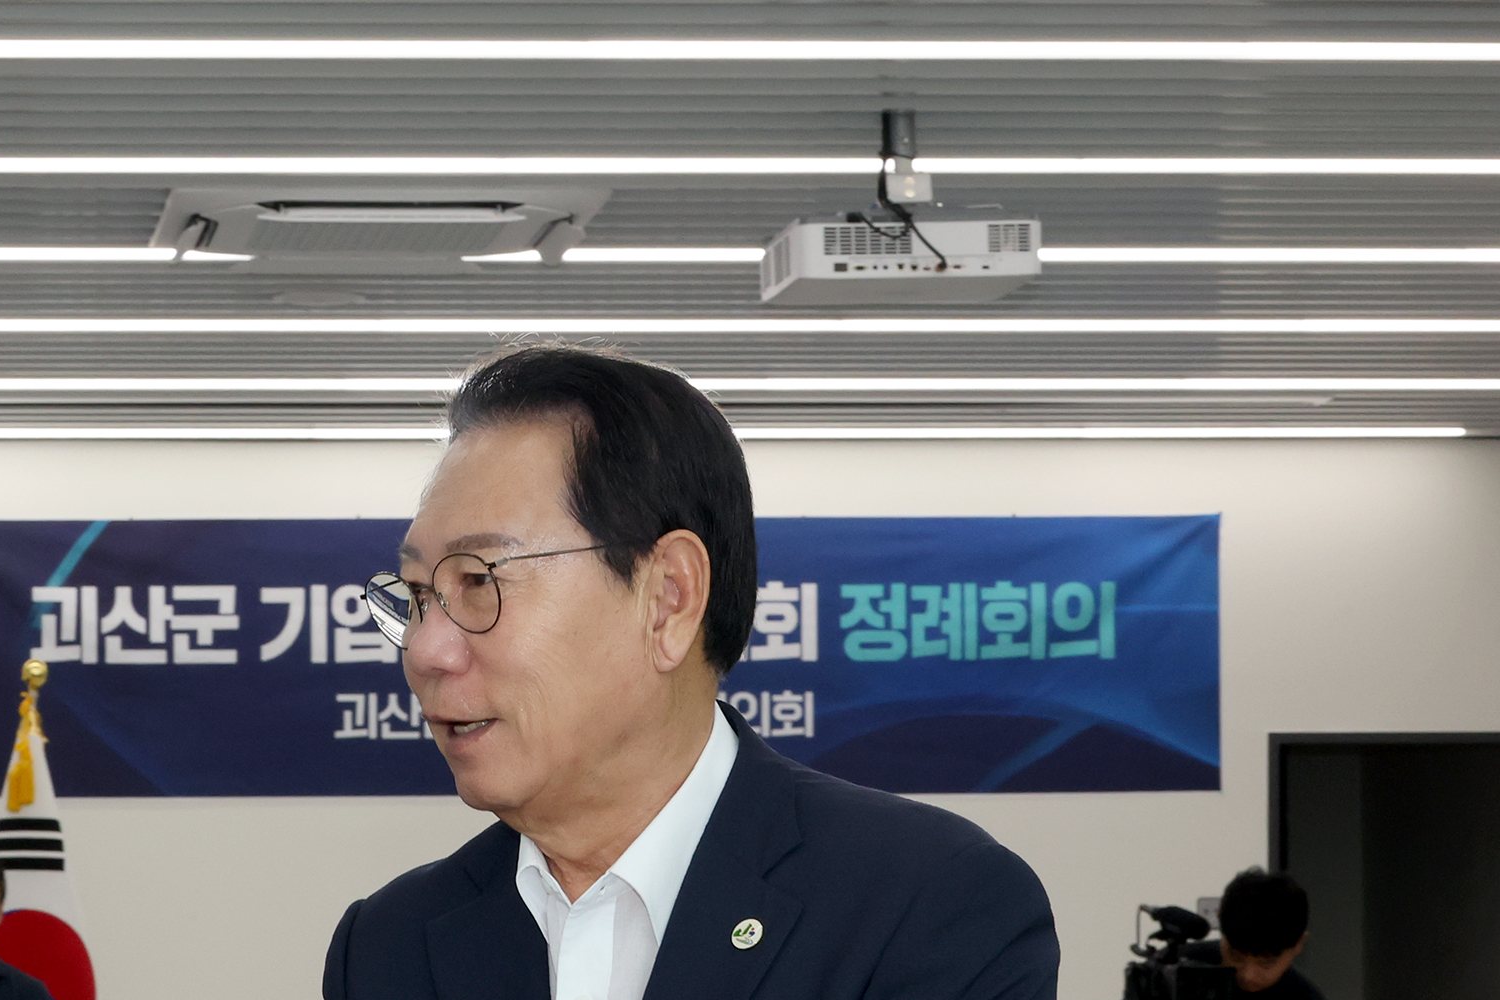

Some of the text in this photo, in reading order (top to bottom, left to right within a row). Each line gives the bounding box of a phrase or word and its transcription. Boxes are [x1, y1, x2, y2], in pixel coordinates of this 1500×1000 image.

[30, 585, 240, 665] 괴산군
[740, 580, 818, 662] 회
[839, 580, 1117, 662] 정례회의
[333, 690, 815, 740] 괴산 의회
